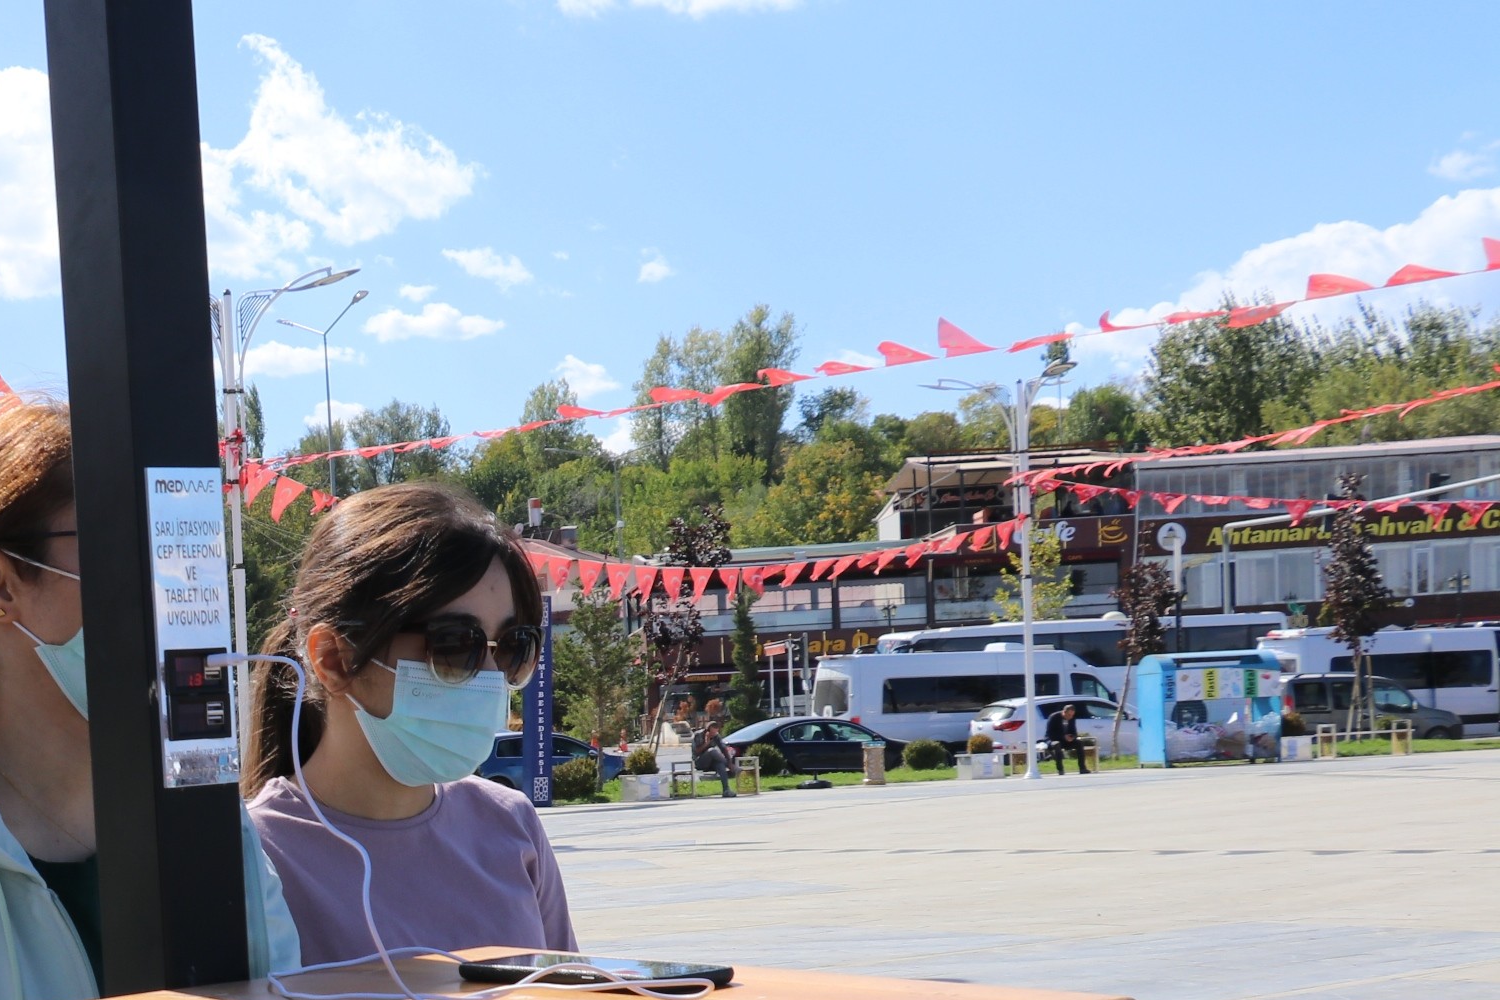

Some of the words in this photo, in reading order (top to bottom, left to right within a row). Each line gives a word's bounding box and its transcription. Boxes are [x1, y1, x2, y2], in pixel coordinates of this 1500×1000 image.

[176, 517, 221, 537] İSTASYONU
[157, 544, 174, 559] CEP
[176, 543, 222, 559] TELEFONU
[185, 566, 197, 580] VE
[165, 588, 197, 603] TABLET
[200, 585, 219, 606] İÇİN
[167, 610, 220, 626] UYGUNDUR
